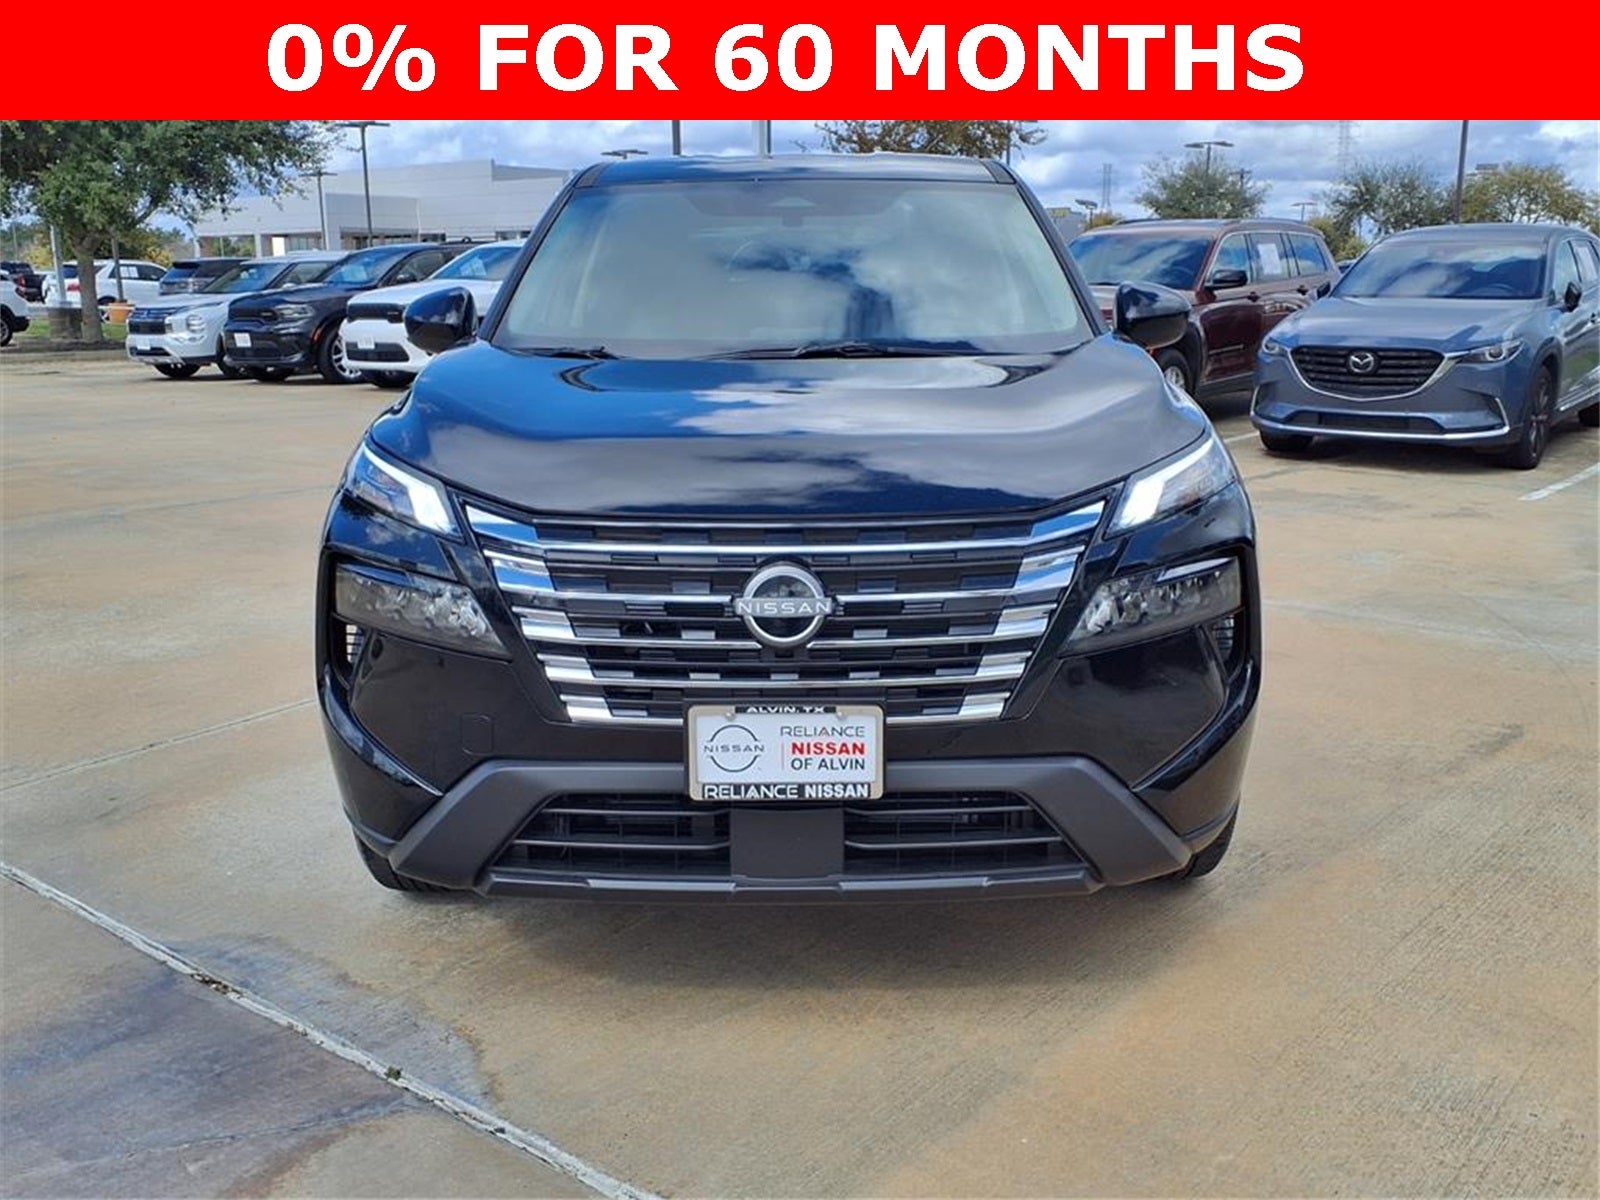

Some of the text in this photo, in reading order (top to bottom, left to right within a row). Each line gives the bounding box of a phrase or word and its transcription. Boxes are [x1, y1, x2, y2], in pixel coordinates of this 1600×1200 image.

[738, 601, 829, 614] NISSAN
[803, 706, 825, 714] TX
[780, 726, 865, 738] RELIANCE
[703, 744, 765, 753] NISSAN
[791, 742, 865, 755] NISSAN
[791, 757, 865, 770] OF ALVIN
[704, 784, 869, 799] RELIANCE NISSAN
